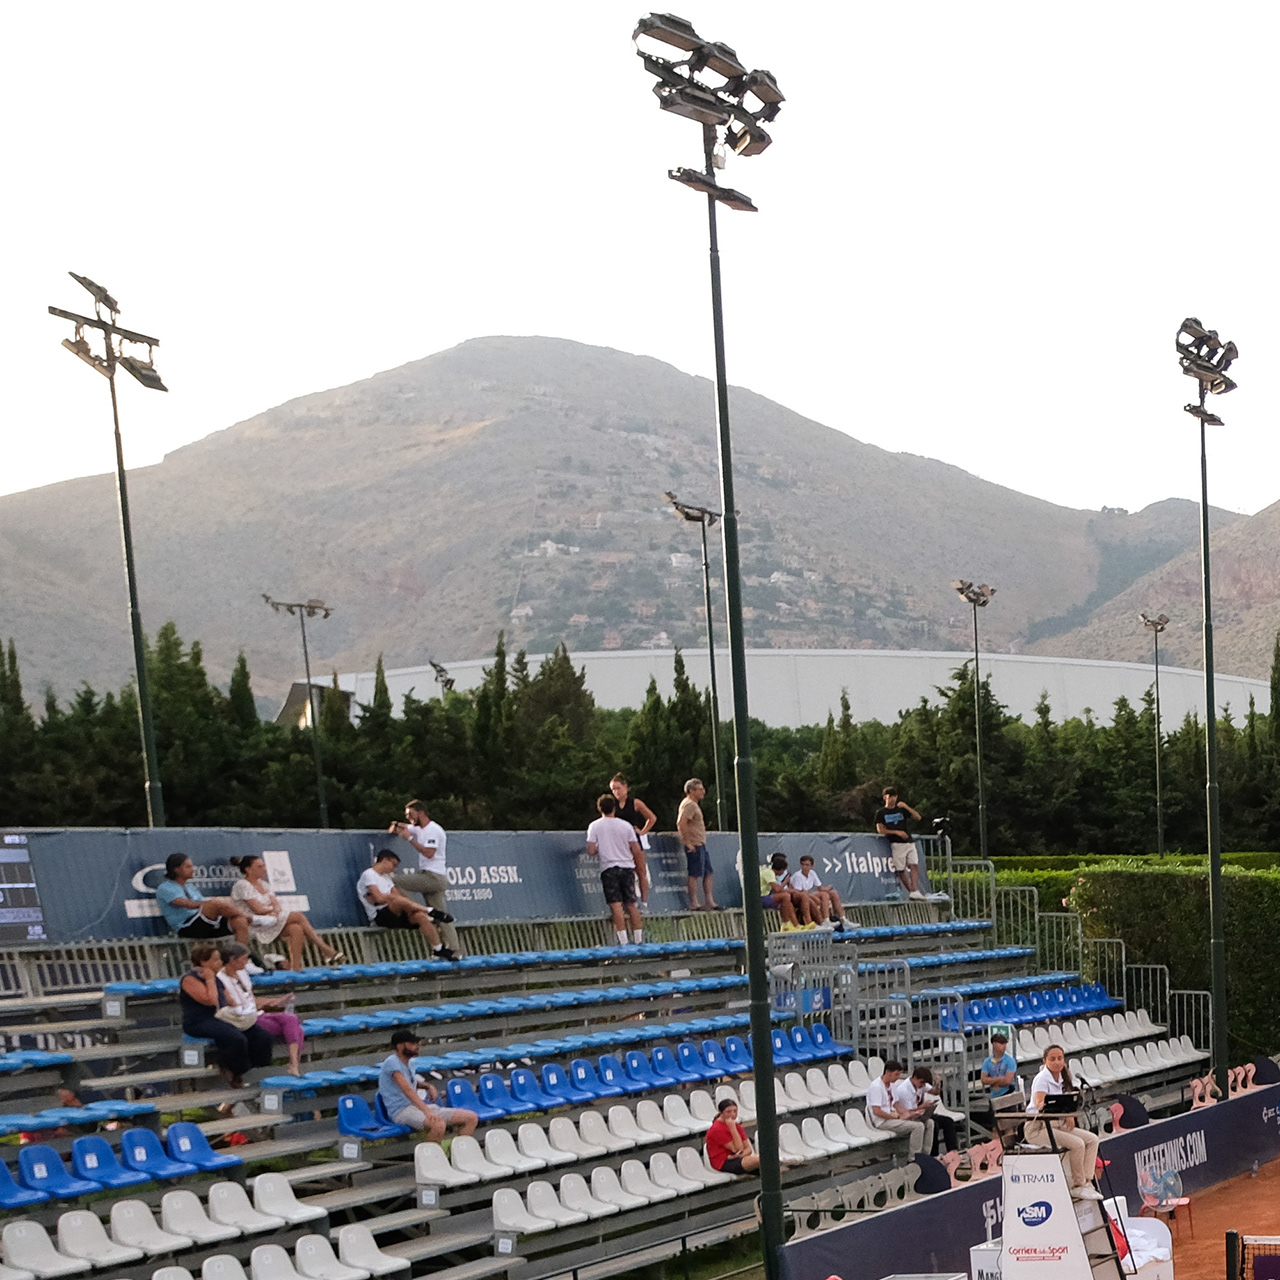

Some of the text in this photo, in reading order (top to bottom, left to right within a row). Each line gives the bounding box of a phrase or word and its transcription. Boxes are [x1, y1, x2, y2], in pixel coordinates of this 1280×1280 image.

[480, 866, 523, 884] ASSN.
[845, 852, 911, 878] Italpre
[1134, 1129, 1208, 1180] WTATENNIS.COM
[1008, 1246, 1038, 1255] Corriere
